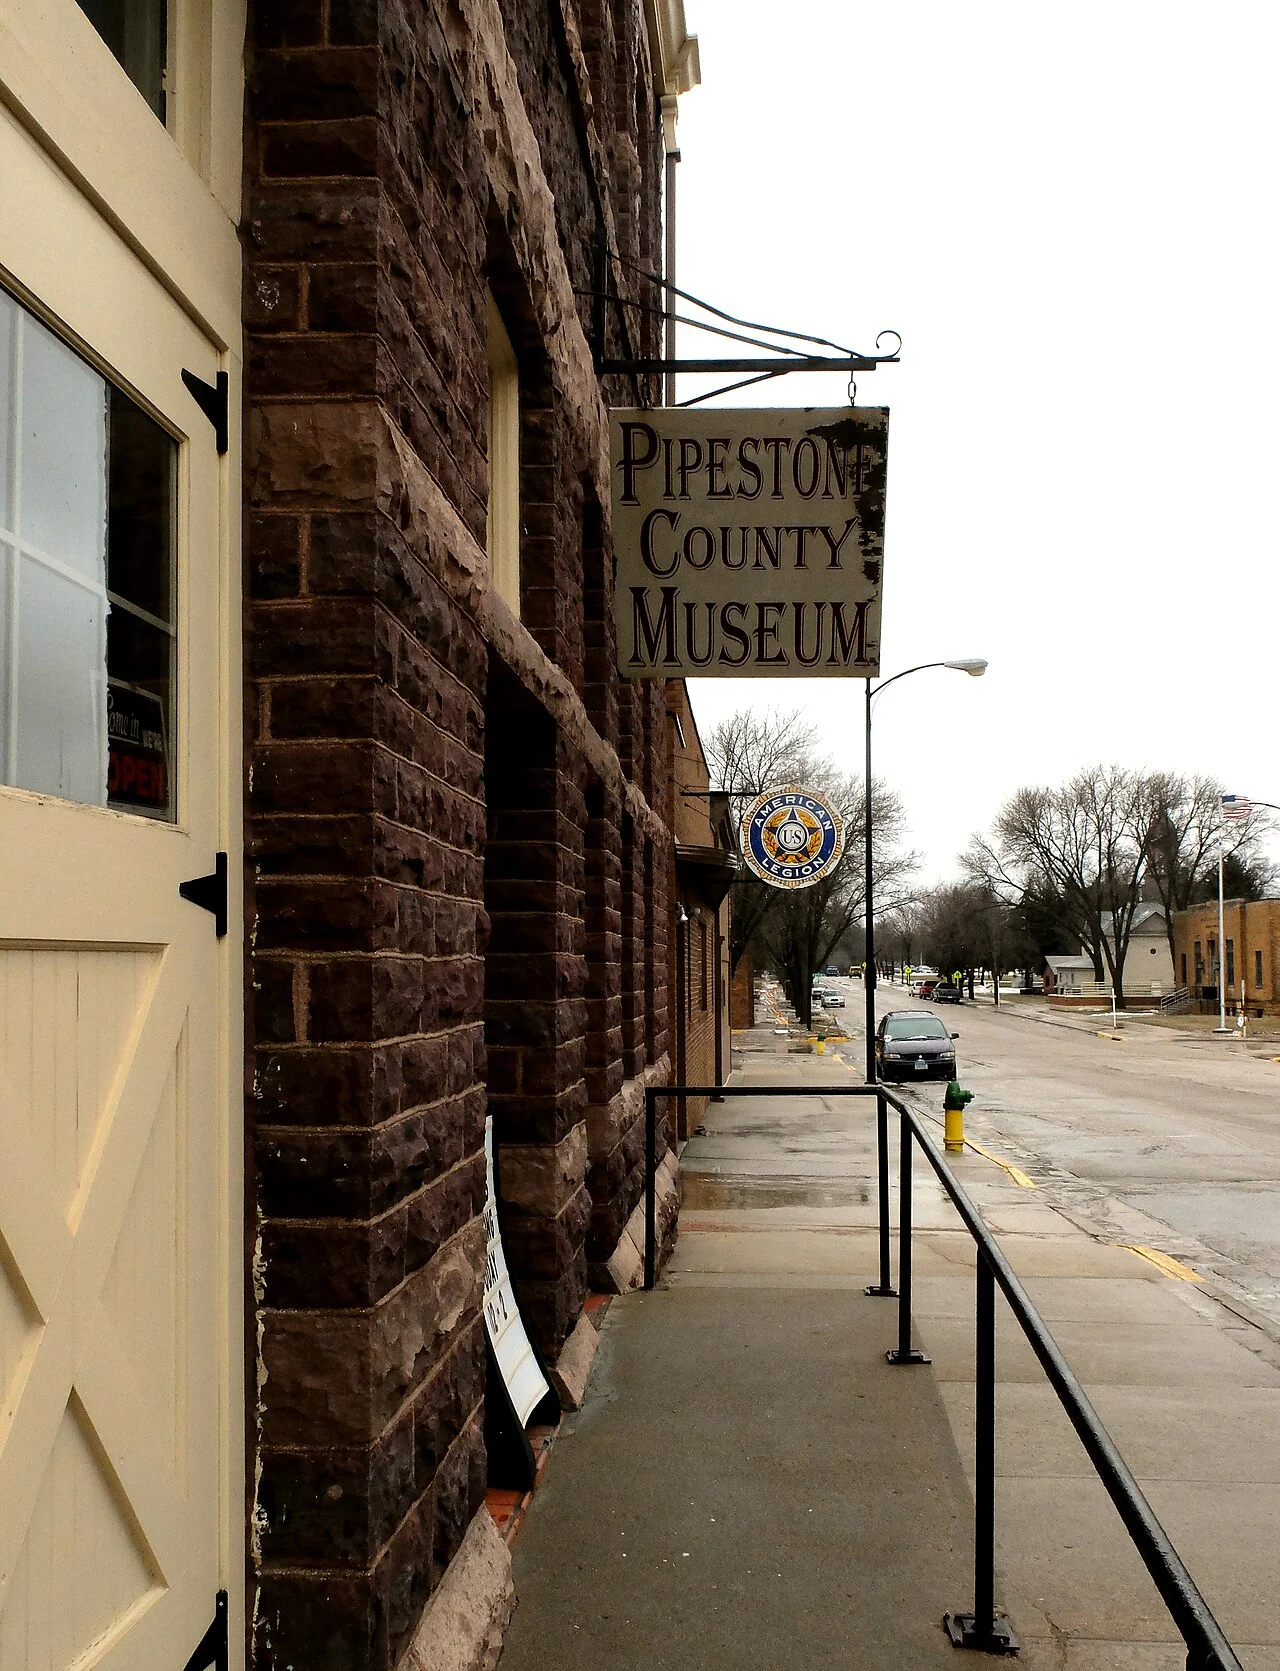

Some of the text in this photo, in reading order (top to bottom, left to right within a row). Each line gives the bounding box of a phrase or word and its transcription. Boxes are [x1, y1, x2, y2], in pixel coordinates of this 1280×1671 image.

[616, 421, 873, 506] PIPESTONE
[640, 508, 861, 579] COUNTY
[628, 586, 870, 667] MUSEUM
[107, 751, 167, 801] OPEN
[754, 795, 833, 831] AMERICAN
[761, 857, 825, 878] LEGION
